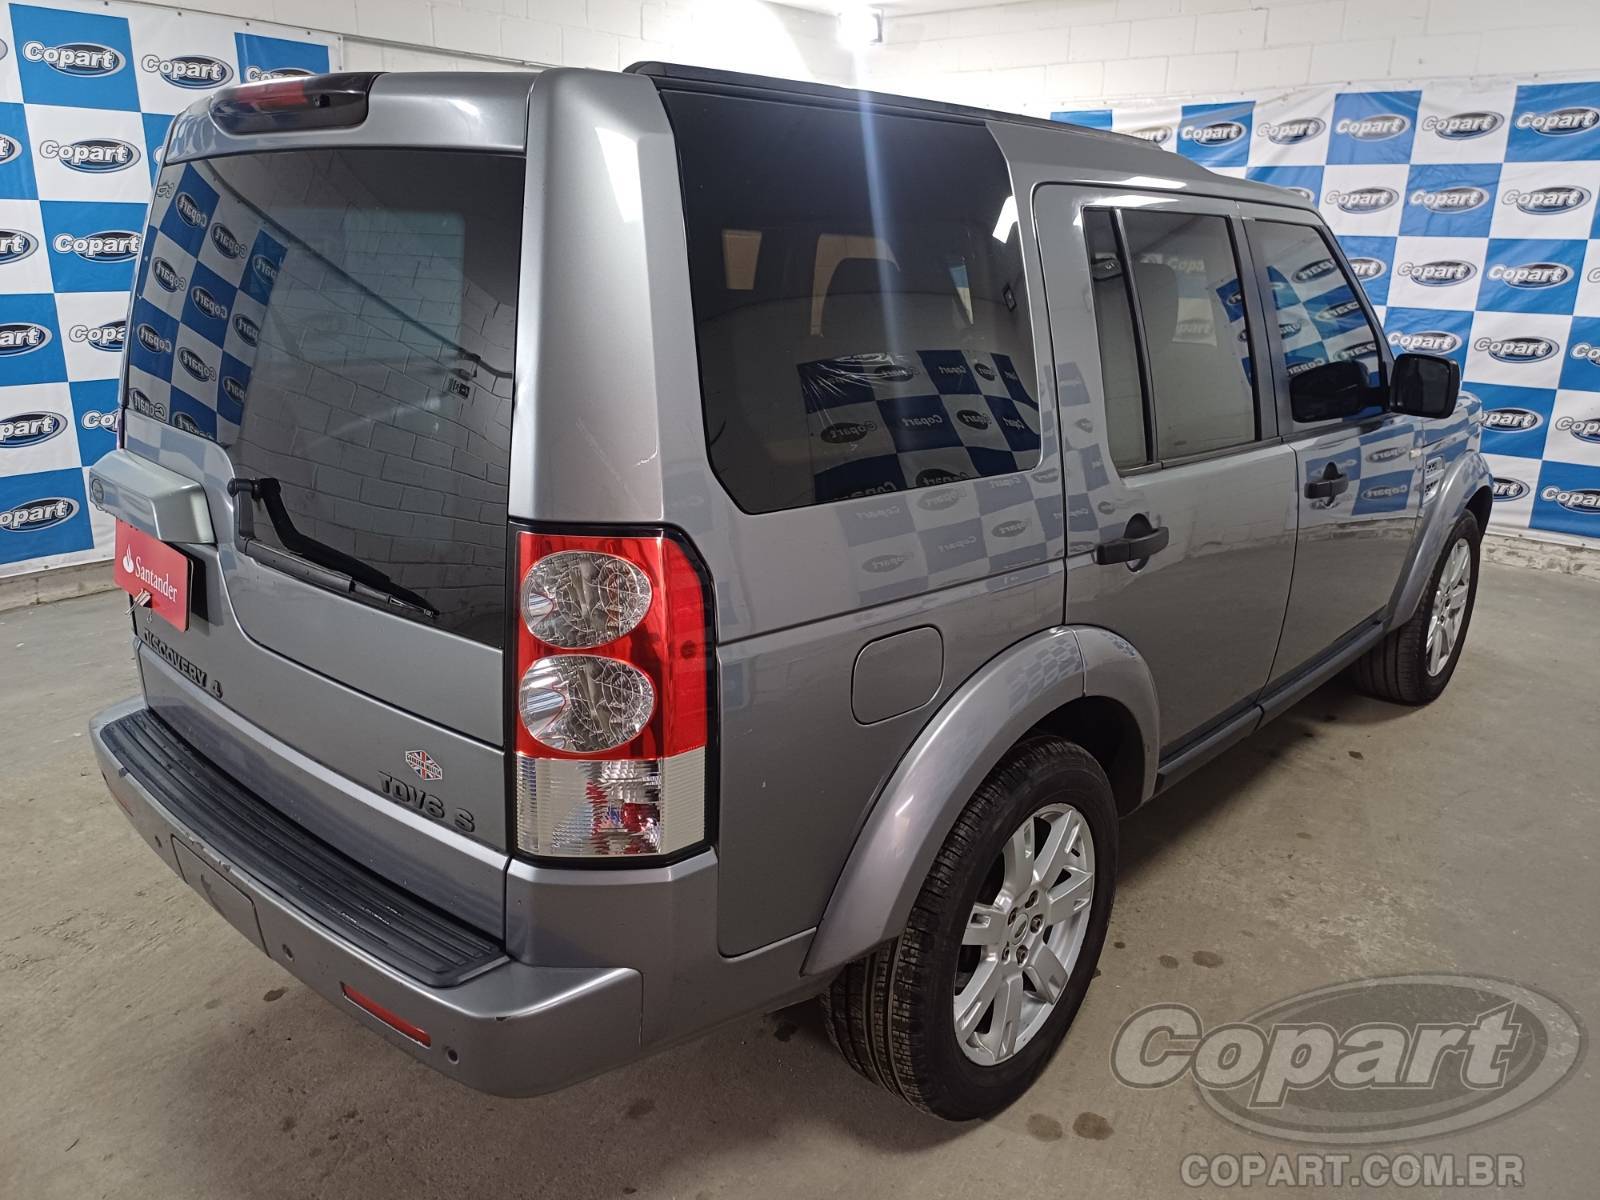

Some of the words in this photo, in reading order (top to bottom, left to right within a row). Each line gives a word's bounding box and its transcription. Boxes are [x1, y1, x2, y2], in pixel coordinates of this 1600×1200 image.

[24, 41, 115, 68] Copart
[142, 55, 222, 81] Copart
[1256, 121, 1319, 142] Copart
[1335, 117, 1407, 139] Copart
[1422, 113, 1495, 136] Copart
[1516, 110, 1597, 132] Copart
[1181, 124, 1240, 143] Copart
[40, 140, 132, 164] Copart
[1325, 188, 1388, 209] Copart
[1410, 188, 1482, 208] Copart
[1502, 188, 1580, 209] Copart
[53, 234, 140, 256] Copart
[1350, 262, 1380, 277] art
[1398, 262, 1470, 281] Copart
[1488, 264, 1566, 283] Copart
[0, 326, 39, 346] art
[69, 325, 126, 345] Copa
[1387, 332, 1456, 350] Copart
[1475, 337, 1551, 357] Copart
[0, 415, 54, 442] part
[1479, 408, 1536, 428] opart
[1556, 417, 1600, 437] Cop
[0, 500, 67, 528] opart
[134, 556, 178, 601] Santander
